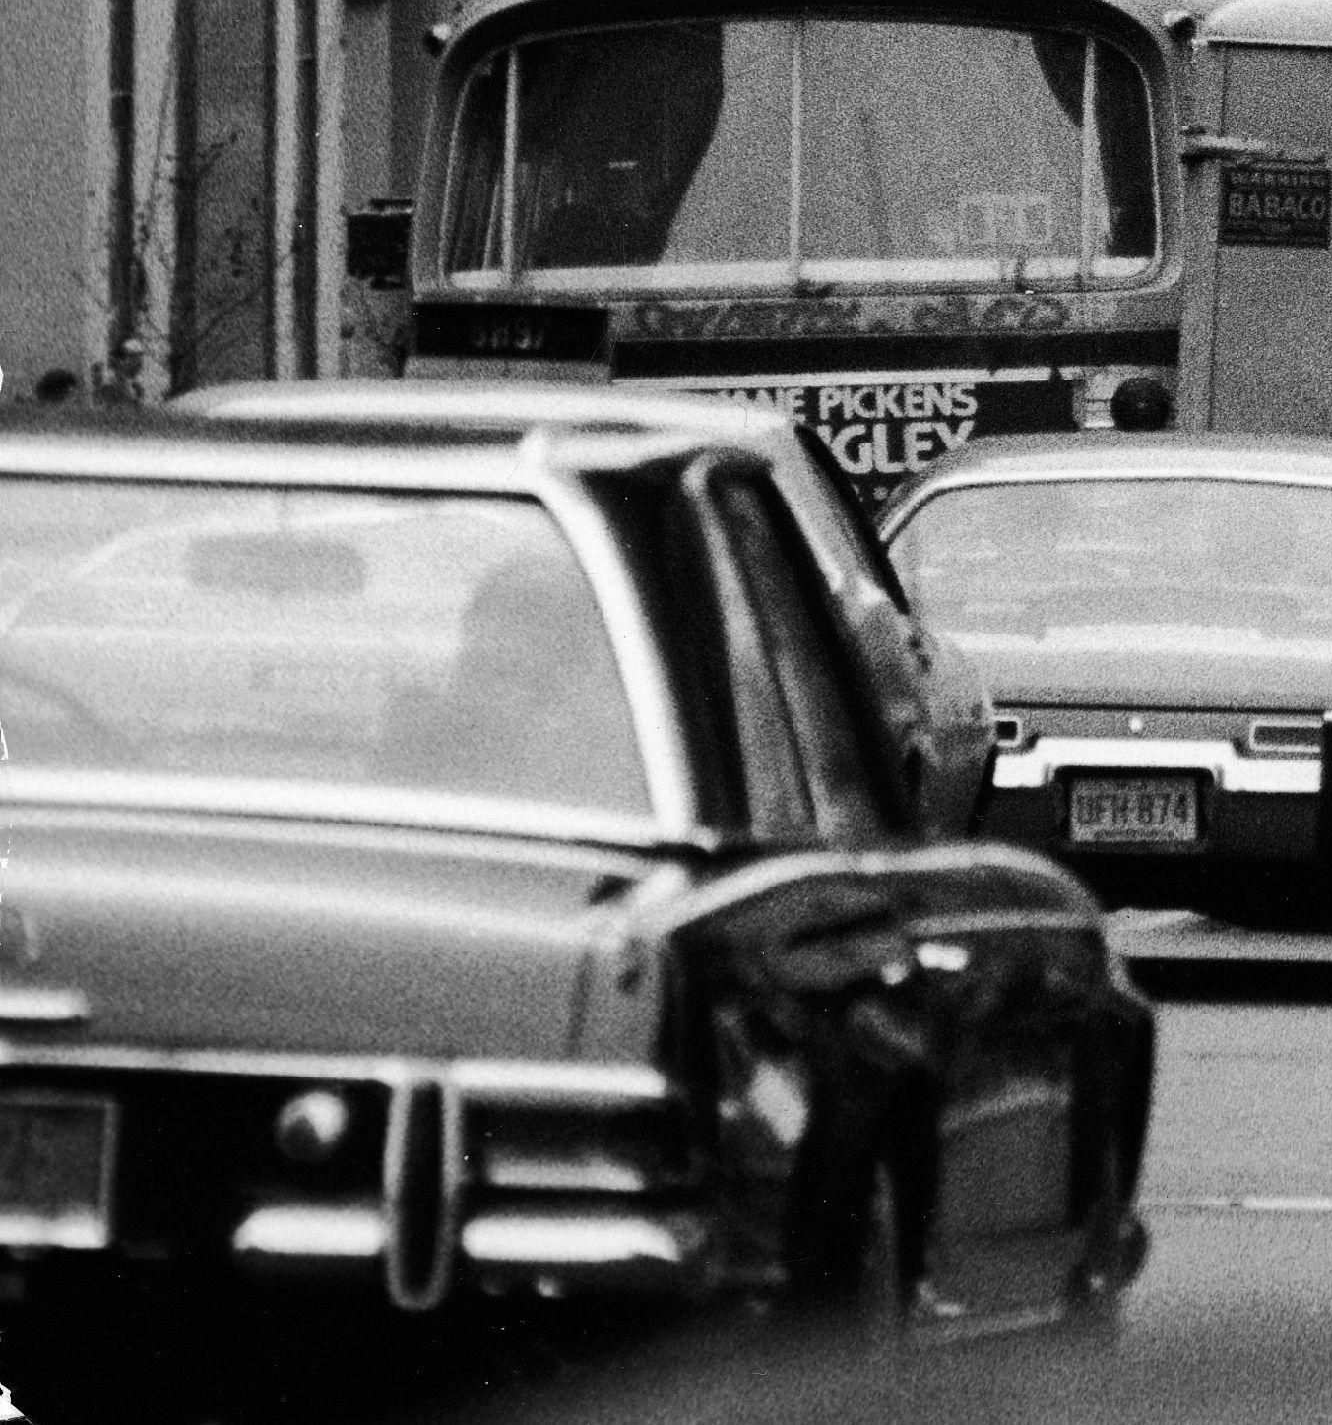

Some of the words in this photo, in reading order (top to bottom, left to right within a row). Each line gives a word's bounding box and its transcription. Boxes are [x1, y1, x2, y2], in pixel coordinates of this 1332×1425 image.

[1228, 171, 1328, 188] WARNING
[1228, 192, 1327, 220] BABACO
[818, 383, 980, 421] PICKENS
[817, 420, 978, 476] GLEY
